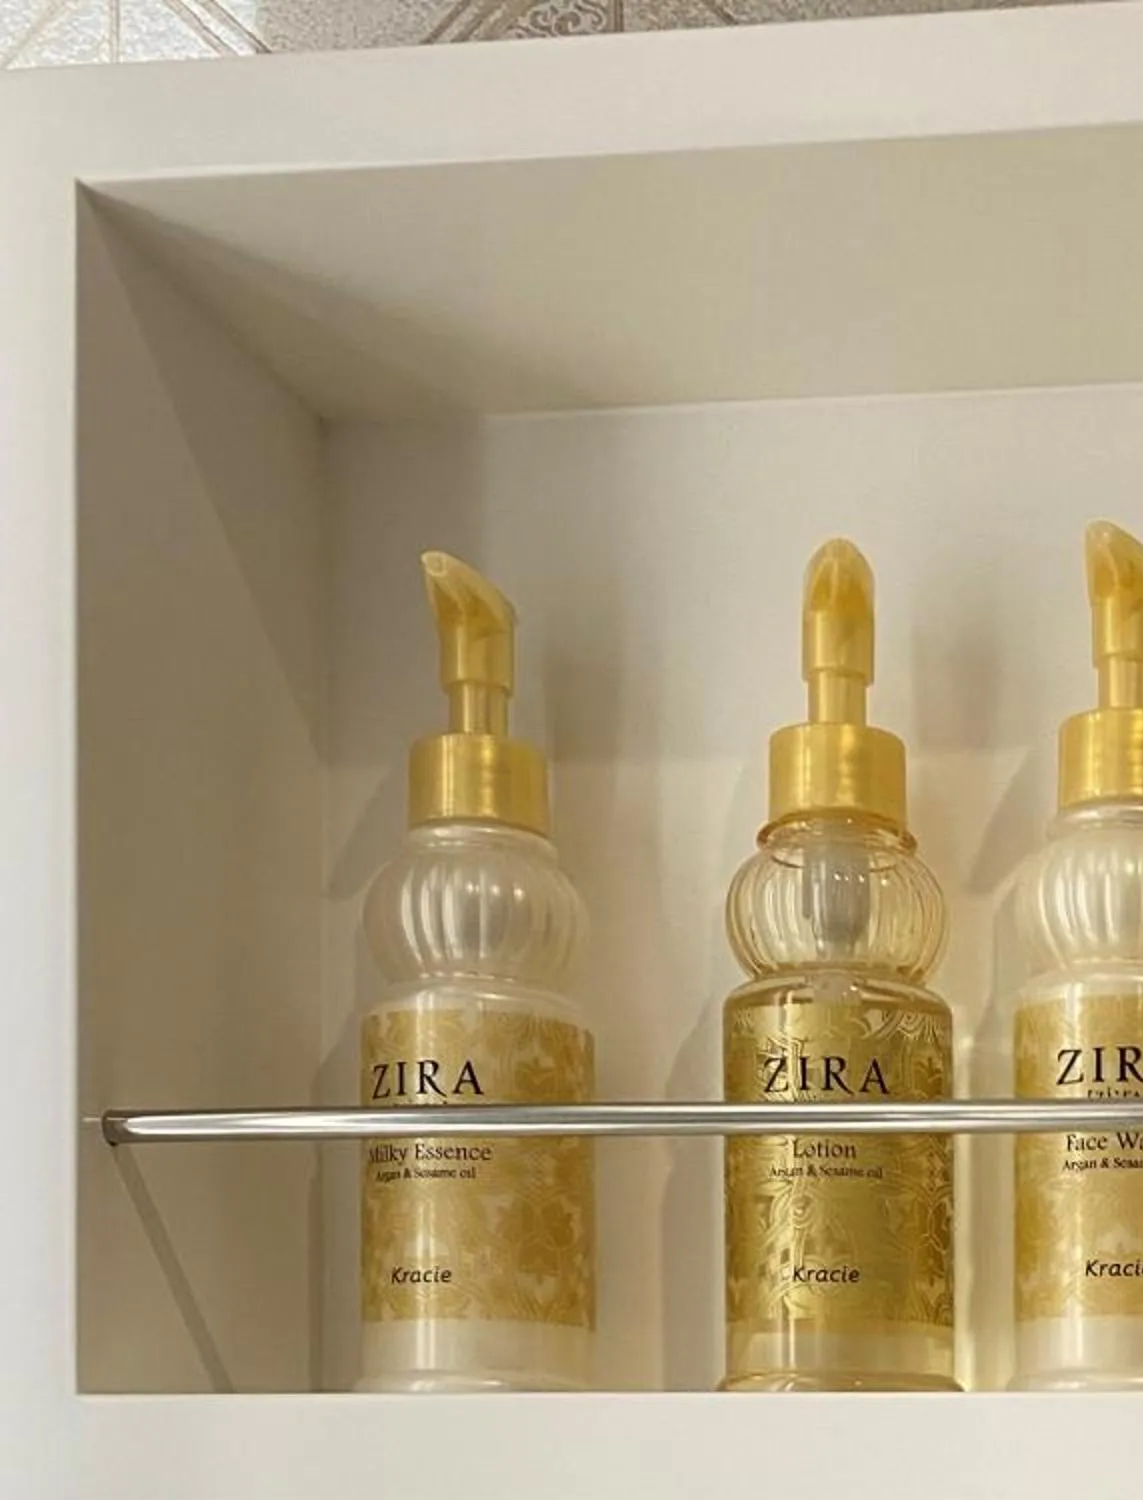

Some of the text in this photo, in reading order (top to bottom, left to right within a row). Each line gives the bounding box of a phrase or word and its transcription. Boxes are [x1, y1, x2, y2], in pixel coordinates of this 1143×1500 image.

[372, 1060, 484, 1099] ZIRA
[763, 1056, 891, 1094] ZIRA
[793, 1140, 857, 1158] Lotion
[1066, 1133, 1108, 1152] Face
[415, 1143, 492, 1161] Essence
[391, 1266, 452, 1284] Kracie
[792, 1265, 860, 1283] Kracie
